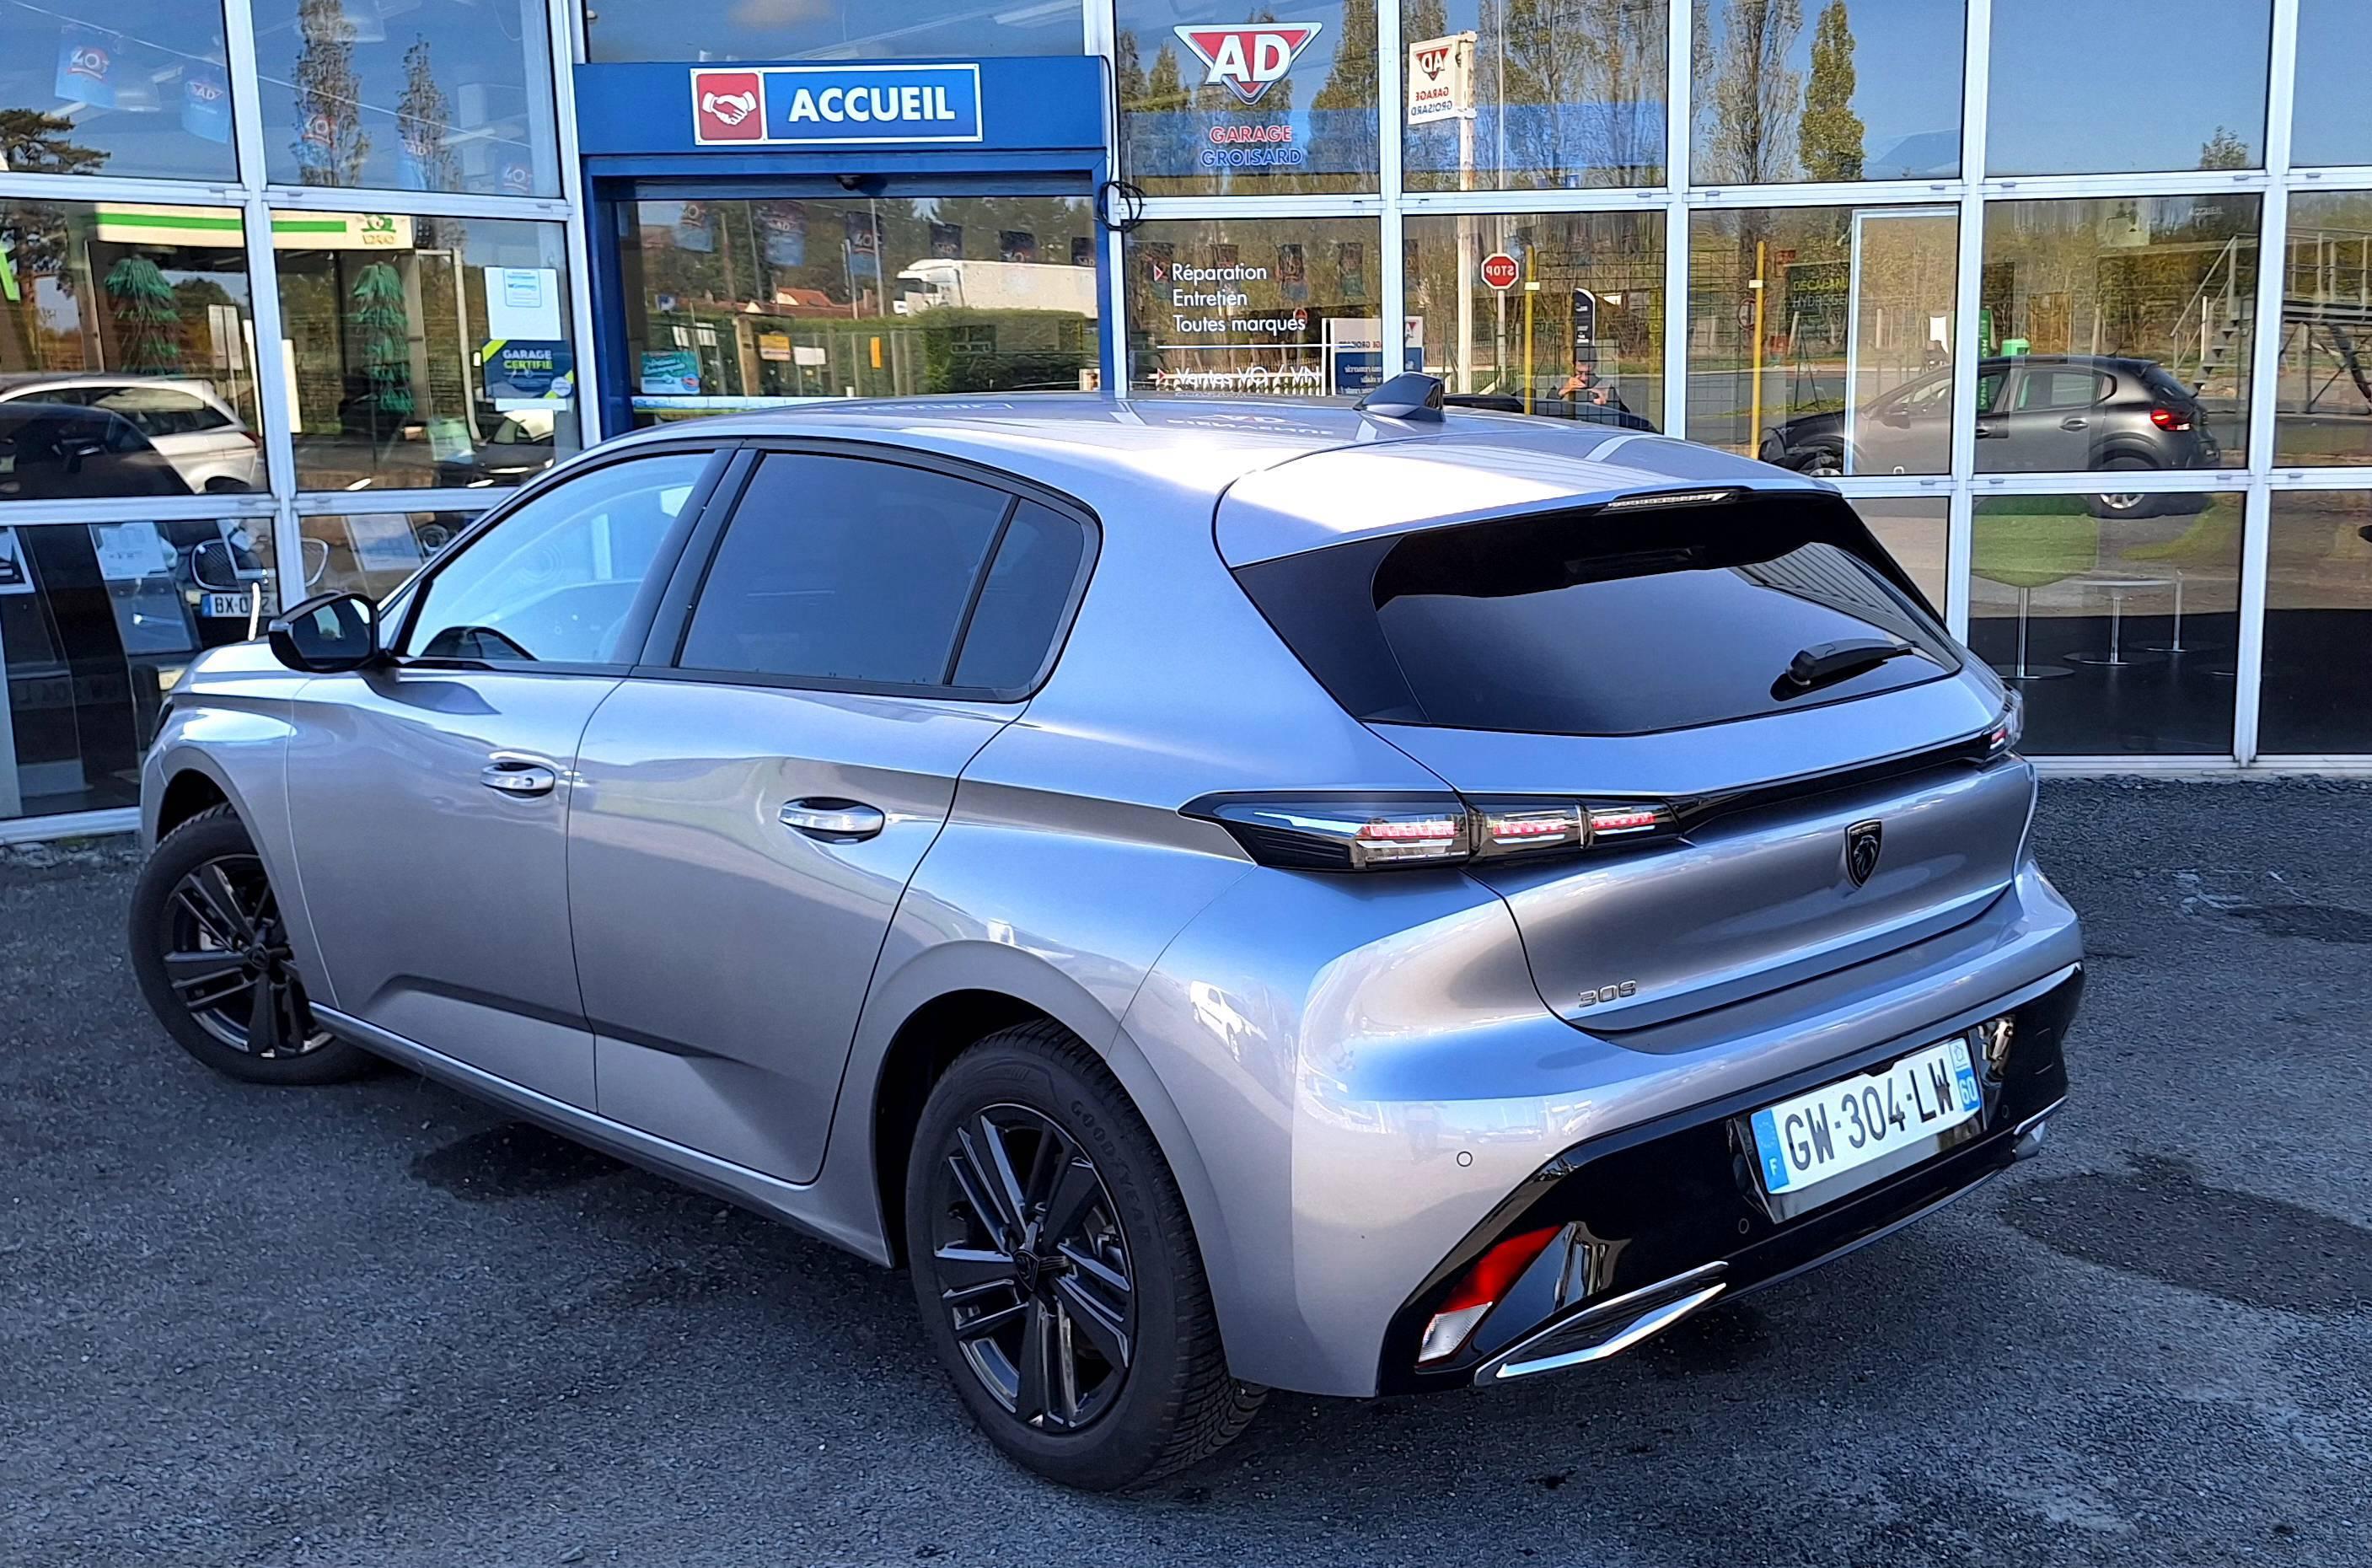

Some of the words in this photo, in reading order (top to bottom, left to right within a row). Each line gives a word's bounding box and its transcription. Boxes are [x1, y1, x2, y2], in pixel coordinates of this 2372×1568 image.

[1205, 32, 1293, 86] AD
[195, 87, 217, 100] AD
[788, 85, 956, 123] ACCUEIL
[1209, 125, 1293, 143] GARAGE
[1200, 148, 1303, 167] GROISARD
[1172, 262, 1268, 287] Réparation
[1173, 288, 1248, 307] Entretien
[1173, 314, 1226, 333] Toutes
[1232, 318, 1307, 336] marques
[502, 349, 552, 360] GARAGE
[1176, 367, 1232, 385] Ventes
[1237, 366, 1268, 384] VO
[1290, 366, 1319, 384] VN
[1578, 979, 1637, 1008] 308
[1768, 1157, 1778, 1177] F
[1784, 1057, 1955, 1172] GW-304-LW
[1960, 1076, 1978, 1105] 60
[1071, 1099, 1153, 1243] GOODYEAR
